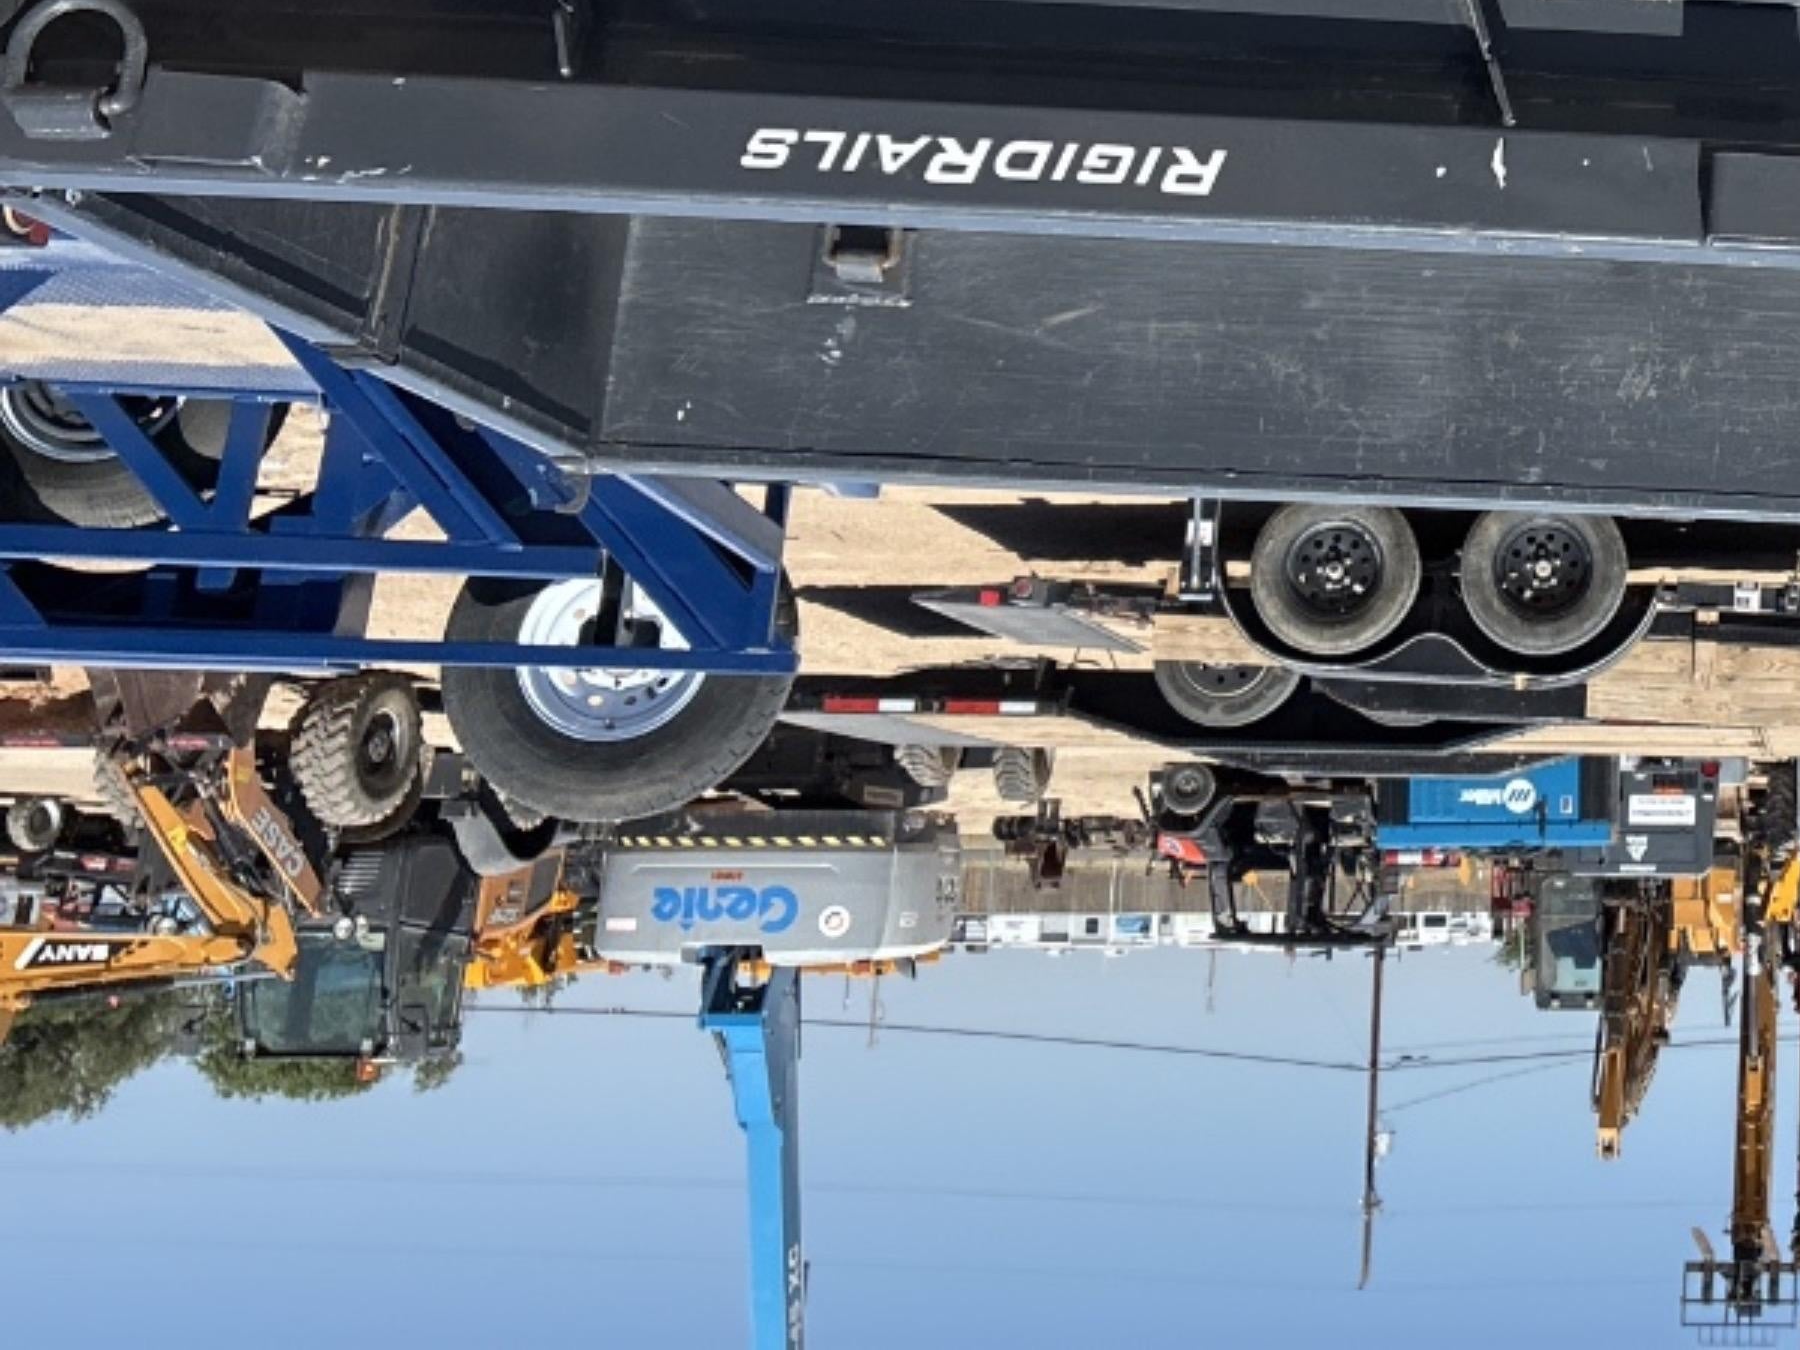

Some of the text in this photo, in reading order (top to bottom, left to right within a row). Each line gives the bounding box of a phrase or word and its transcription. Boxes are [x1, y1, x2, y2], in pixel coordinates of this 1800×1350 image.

[739, 128, 1227, 196] RIGIDRAILS
[250, 806, 304, 878] CASE
[650, 884, 799, 935] Genie
